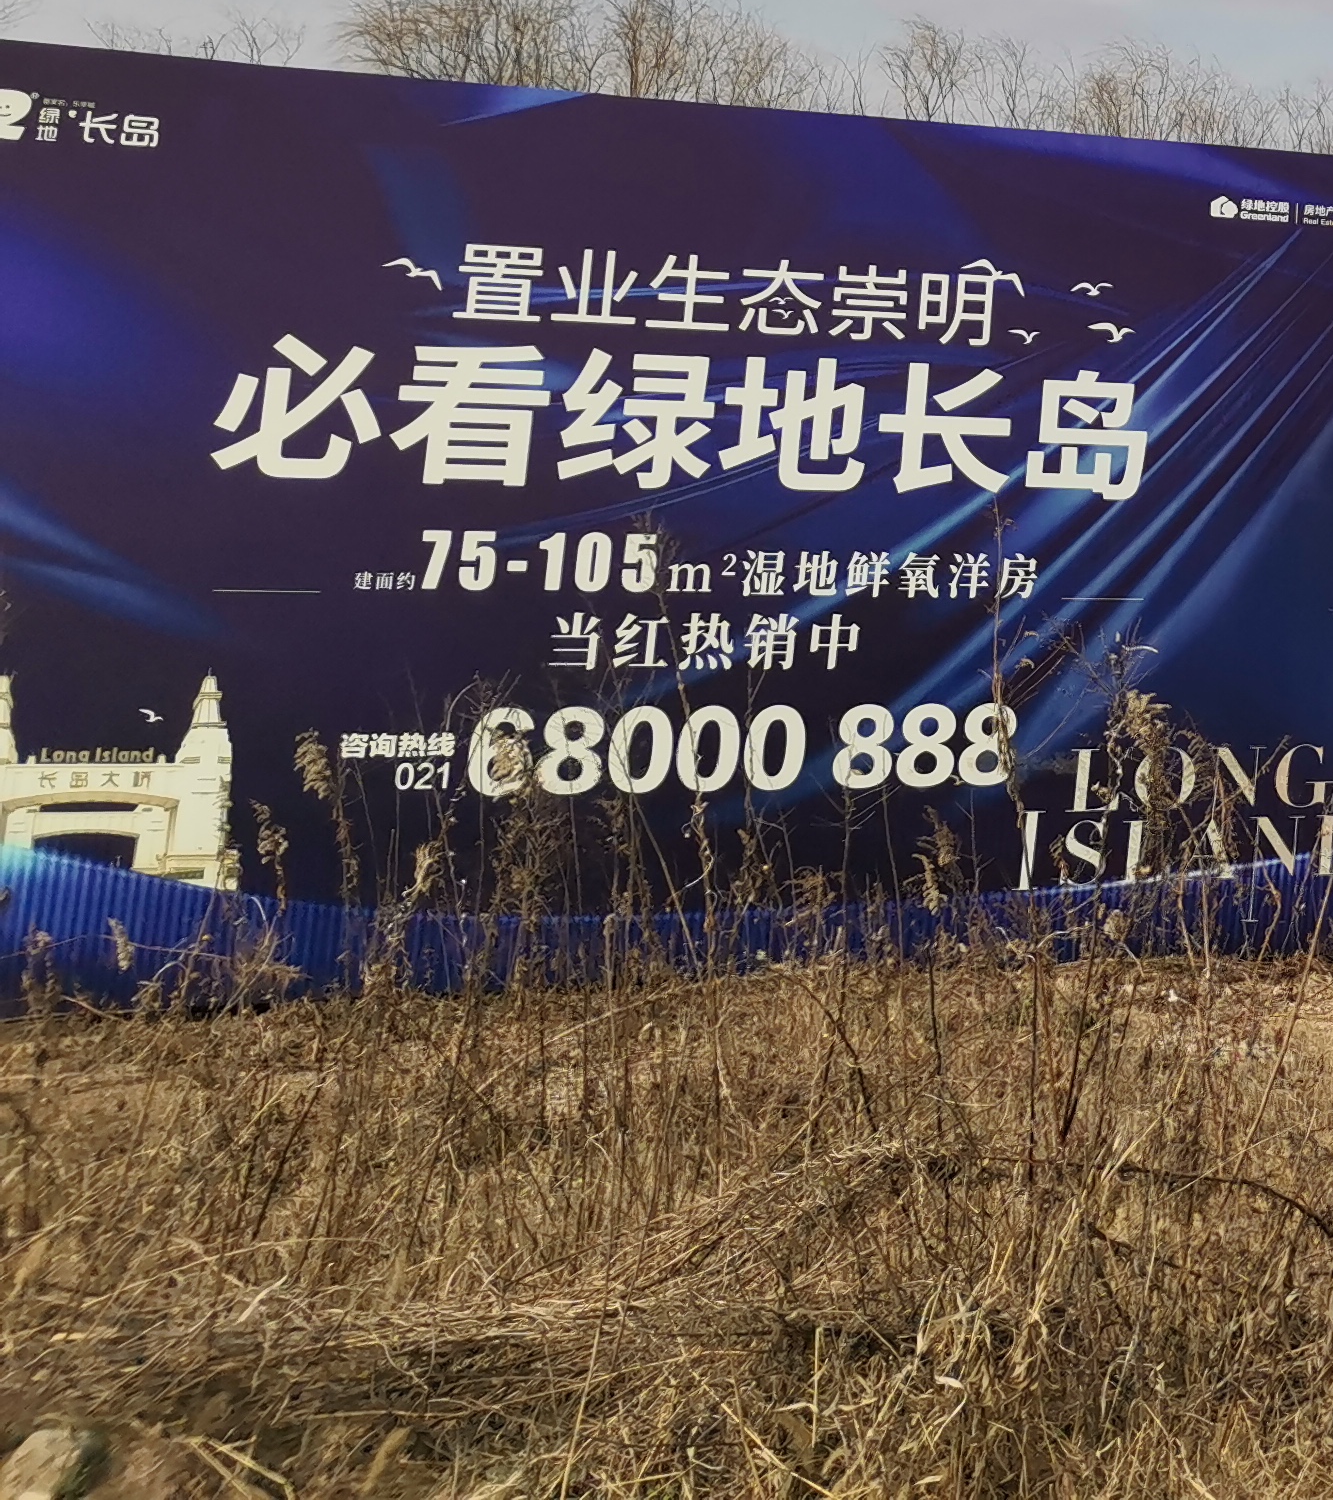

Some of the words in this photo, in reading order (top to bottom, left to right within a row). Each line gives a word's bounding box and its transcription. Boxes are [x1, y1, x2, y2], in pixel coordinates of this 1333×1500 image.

[79, 111, 159, 147] 长岛
[1240, 212, 1289, 222] Greenland
[1241, 199, 1290, 213] 绿地控股
[452, 243, 1000, 346] 置业生态崇明
[210, 334, 1149, 500] 必看绿地长岛
[548, 612, 862, 671] 当红热销中
[95, 747, 155, 763] Island
[340, 732, 455, 759] 咨询热线
[467, 704, 806, 796] 68000
[832, 702, 1018, 789] 888
[395, 762, 451, 790] 021
